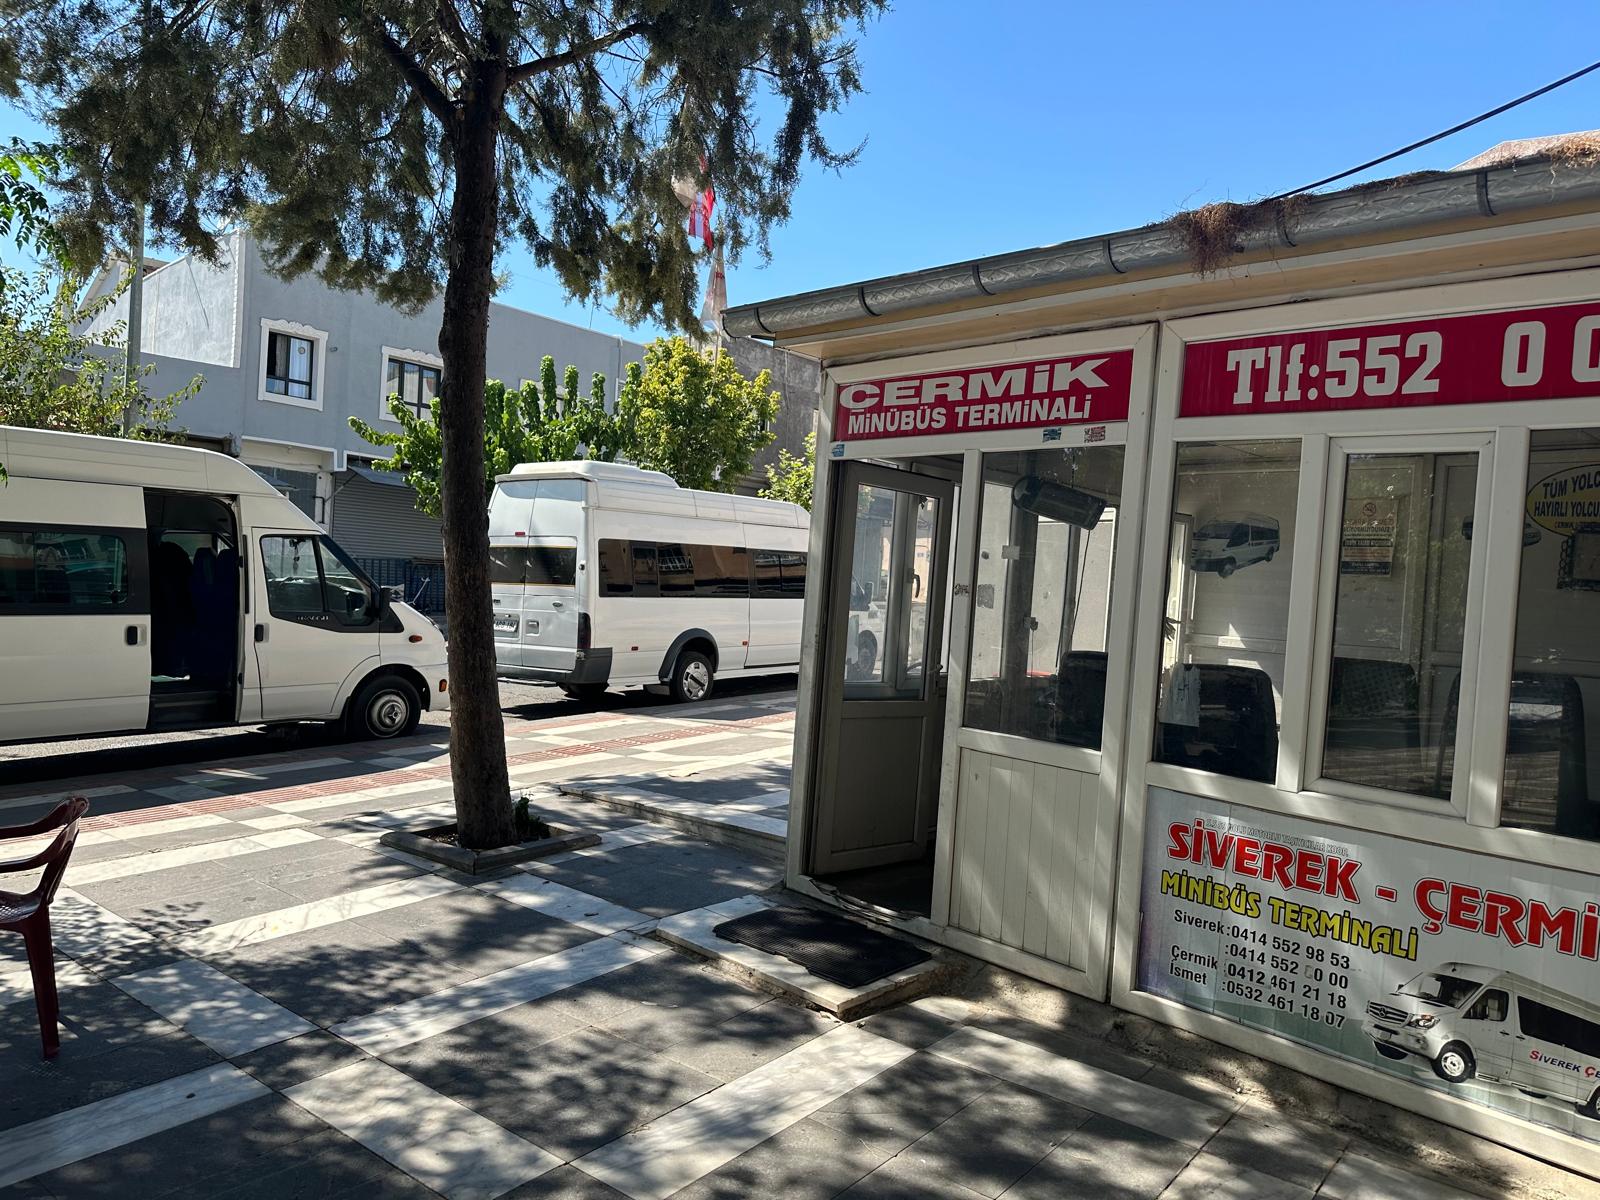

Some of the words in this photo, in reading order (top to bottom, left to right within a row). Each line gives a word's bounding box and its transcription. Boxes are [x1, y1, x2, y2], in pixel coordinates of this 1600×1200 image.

[1226, 331, 1442, 405] Tlf:552
[1543, 478, 1567, 499] TÜM
[1534, 501, 1568, 517] HAYIRLI
[1570, 500, 1600, 517] YOLCU
[1168, 818, 1362, 904] SİVEREK
[1413, 877, 1600, 961] ÇERMİ
[1161, 870, 1261, 919] MİNİBÜS
[1268, 896, 1418, 961] TERMİNALİ
[1272, 936, 1300, 956] 552
[1306, 945, 1325, 963] 98
[1330, 953, 1350, 970] 53
[1171, 945, 1218, 970] Çermik
[1270, 974, 1295, 993] 461
[1302, 984, 1320, 1001] 21
[1327, 992, 1347, 1009] 18
[1270, 955, 1299, 975] 552
[1329, 972, 1348, 990] 00
[1267, 994, 1294, 1013] 461
[1301, 1004, 1319, 1021] 18
[1325, 1011, 1345, 1028] 07
